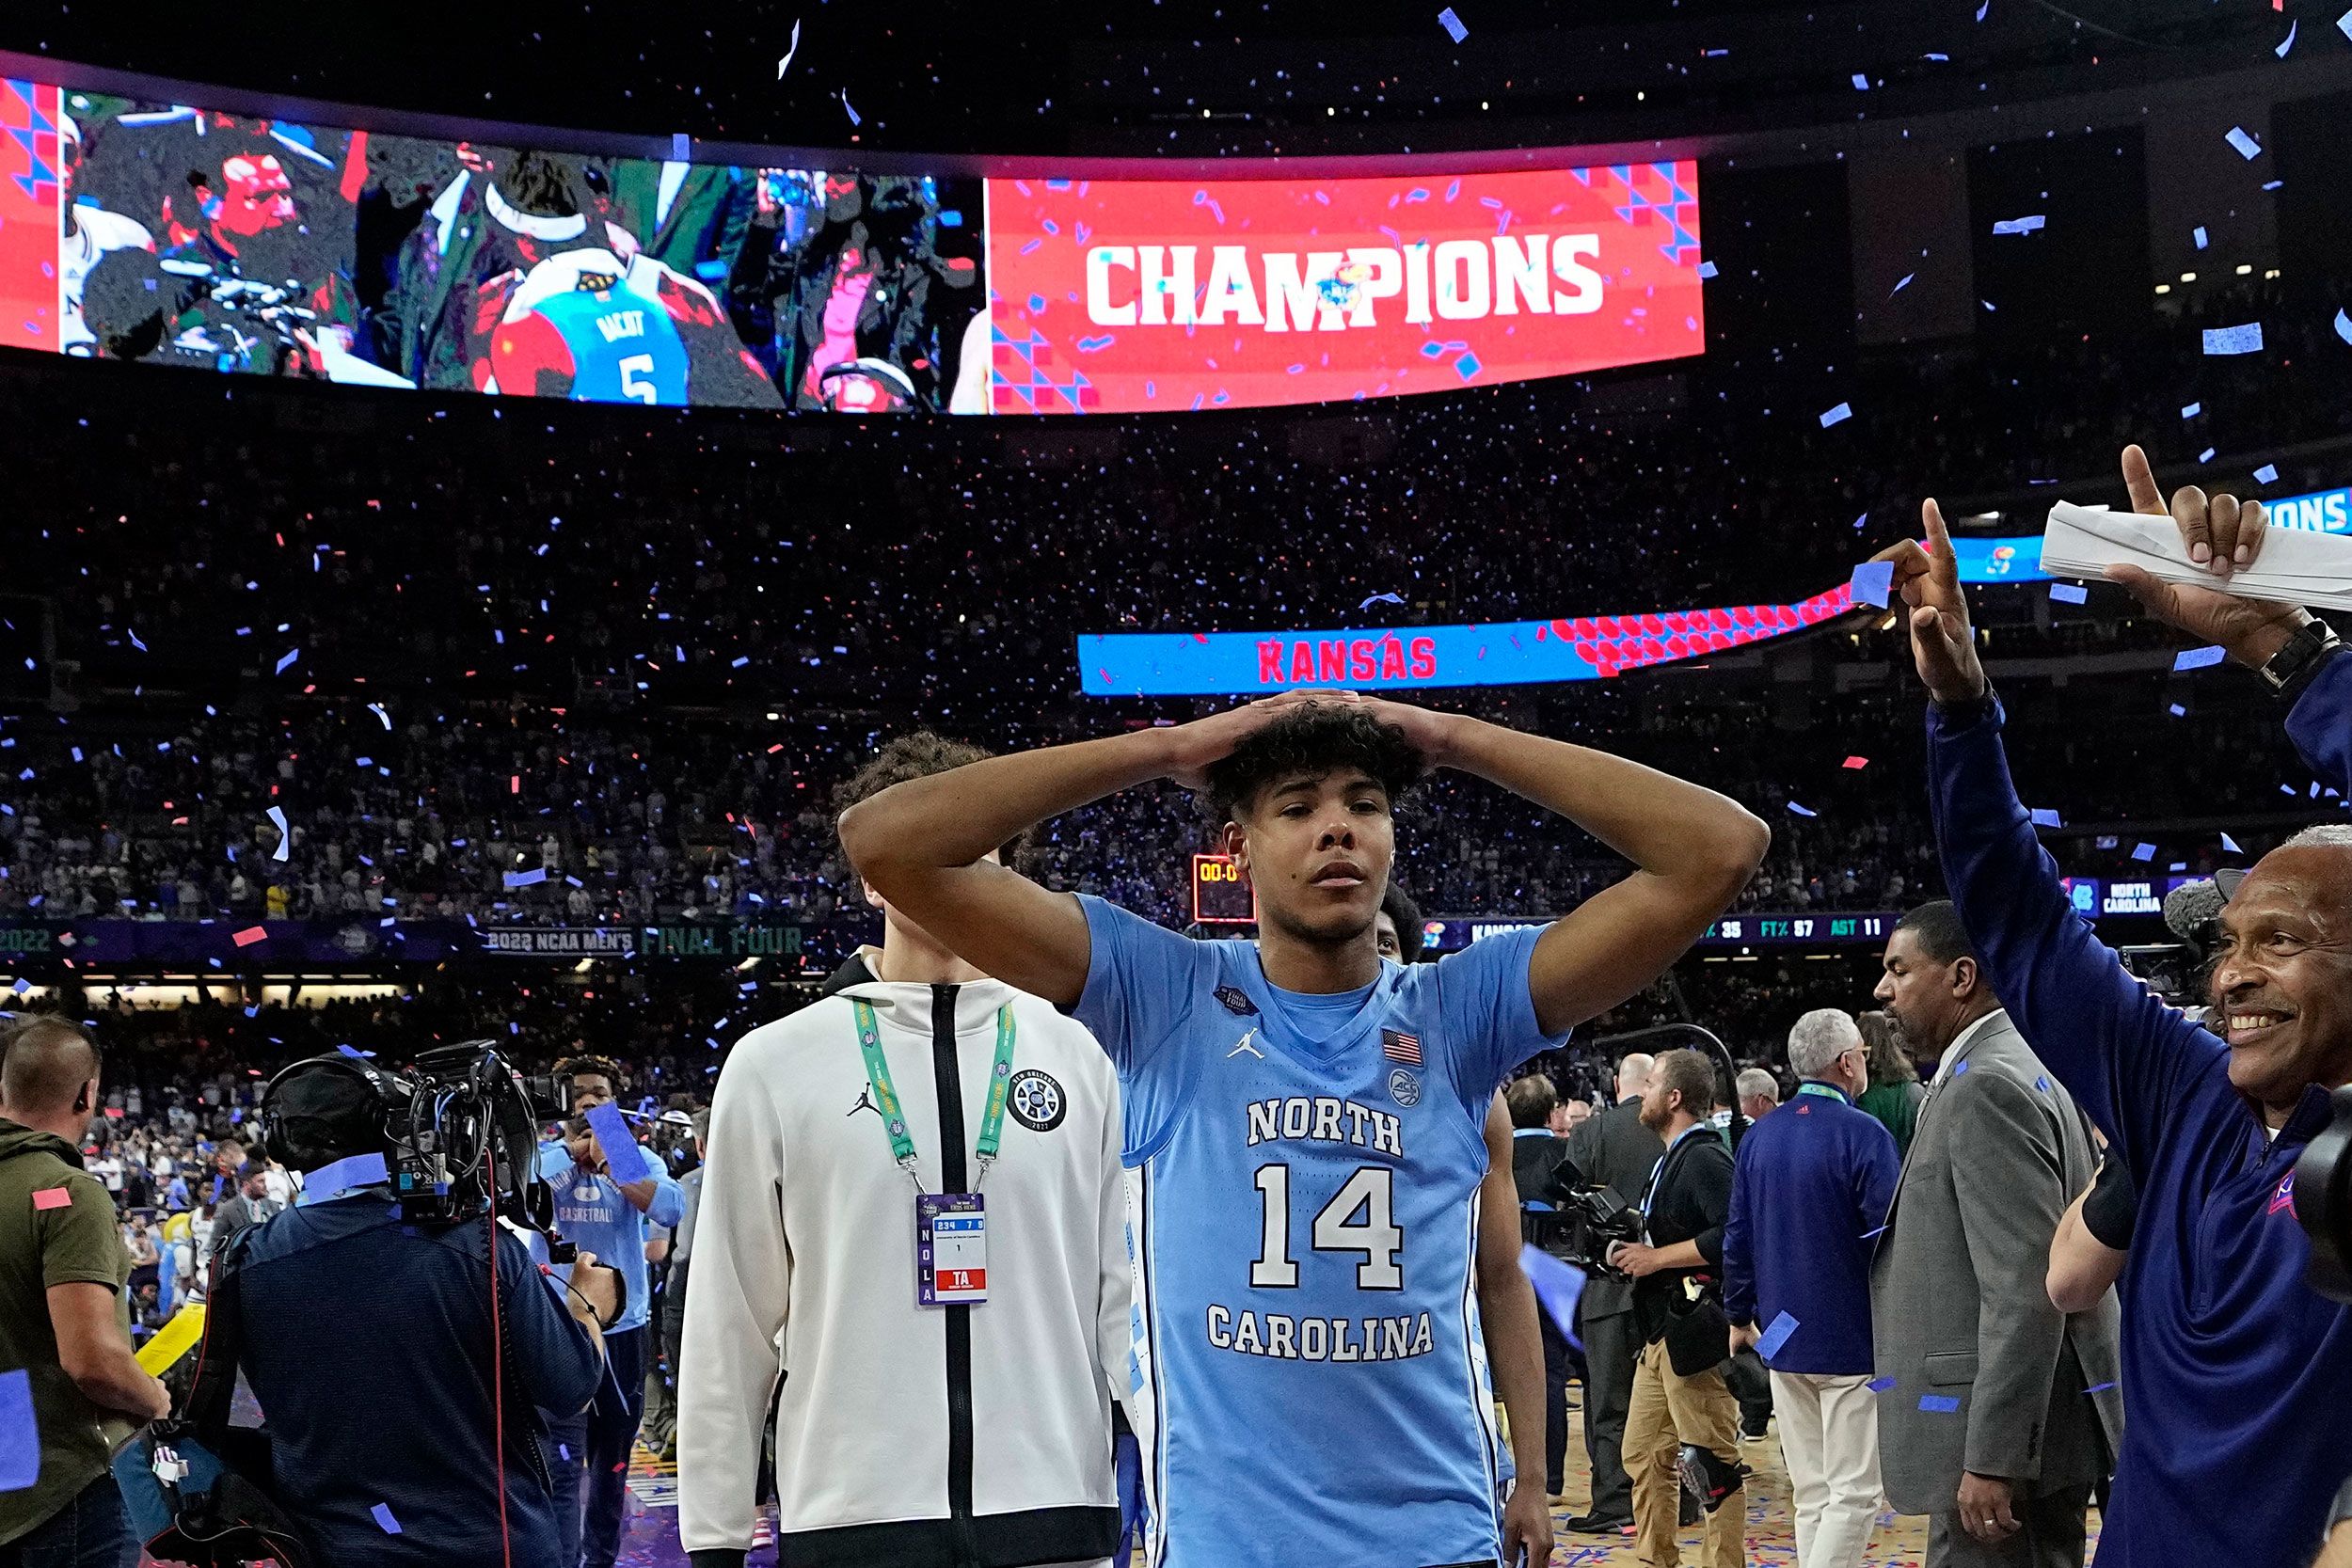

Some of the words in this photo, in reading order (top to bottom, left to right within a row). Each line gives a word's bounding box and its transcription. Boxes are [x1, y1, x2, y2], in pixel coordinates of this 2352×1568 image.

[1086, 233, 1604, 333] CHAMPIONS
[619, 353, 658, 404] 5
[1256, 636, 1437, 684] KANSAS
[2103, 896, 2161, 913] CAROLINA
[2110, 882, 2151, 898] NORTH
[536, 932, 580, 950] NCAA
[583, 932, 633, 951] MEN'S
[641, 927, 723, 955] FINAL
[730, 927, 803, 955] FOUR
[1722, 921, 1741, 939] 35
[1760, 920, 1788, 938] FT%
[1793, 919, 1814, 937] 57
[1830, 919, 1856, 937] AST
[1864, 918, 1881, 936] 11
[1248, 1096, 1404, 1158] NORTH
[1249, 1163, 1405, 1291] 14
[952, 1271, 970, 1286] TA
[1206, 1303, 1434, 1363] CAROLINA
